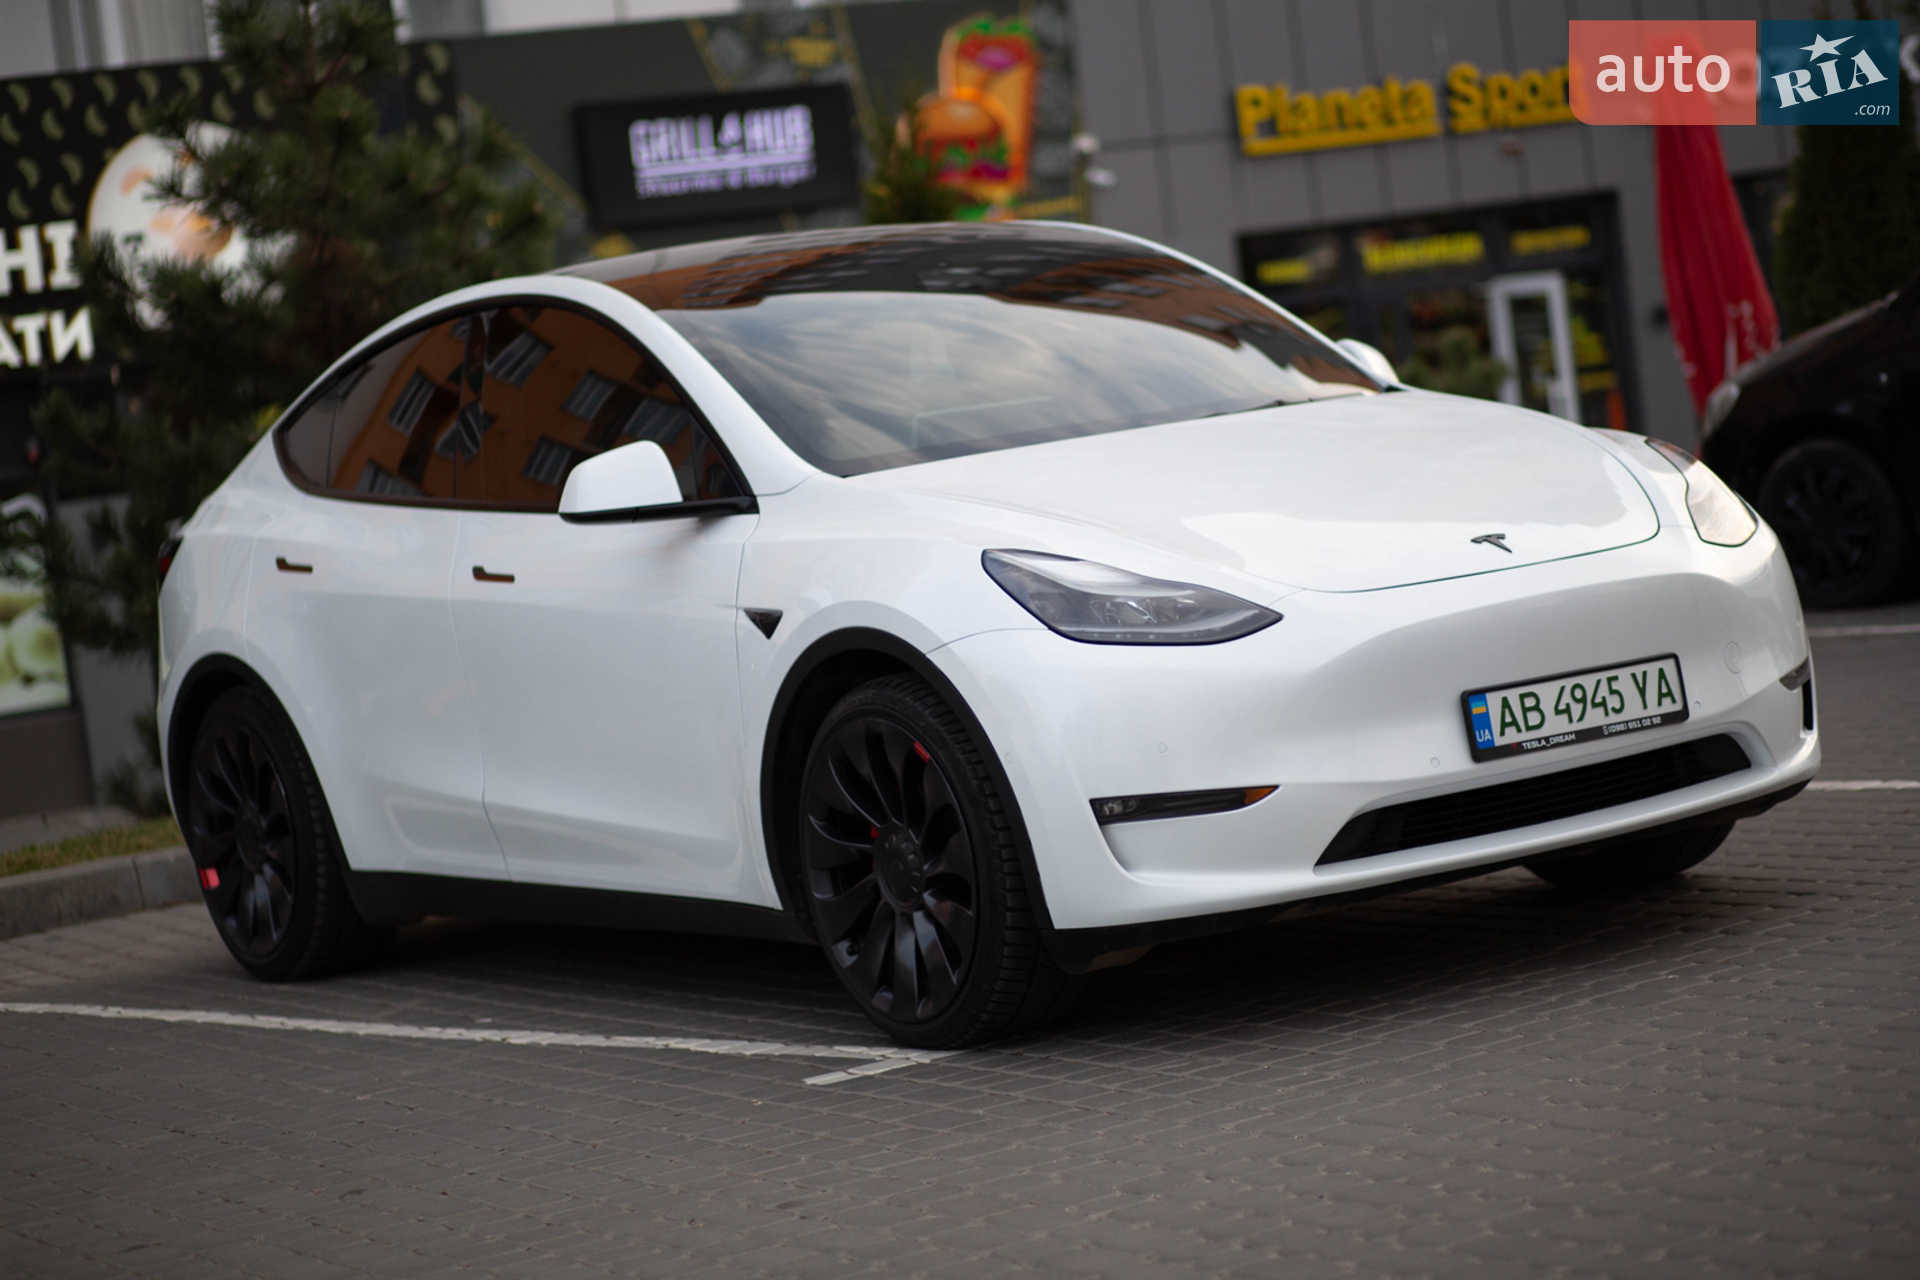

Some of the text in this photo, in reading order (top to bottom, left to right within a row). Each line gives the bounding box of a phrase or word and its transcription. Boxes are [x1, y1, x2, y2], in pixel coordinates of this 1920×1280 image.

[629, 104, 815, 167] GRILL HUB
[1235, 76, 1439, 138] Planeta
[1499, 667, 1677, 737] AB 4945 YA
[1476, 729, 1492, 743] UA
[1522, 733, 1576, 750] TESLA_DREAM
